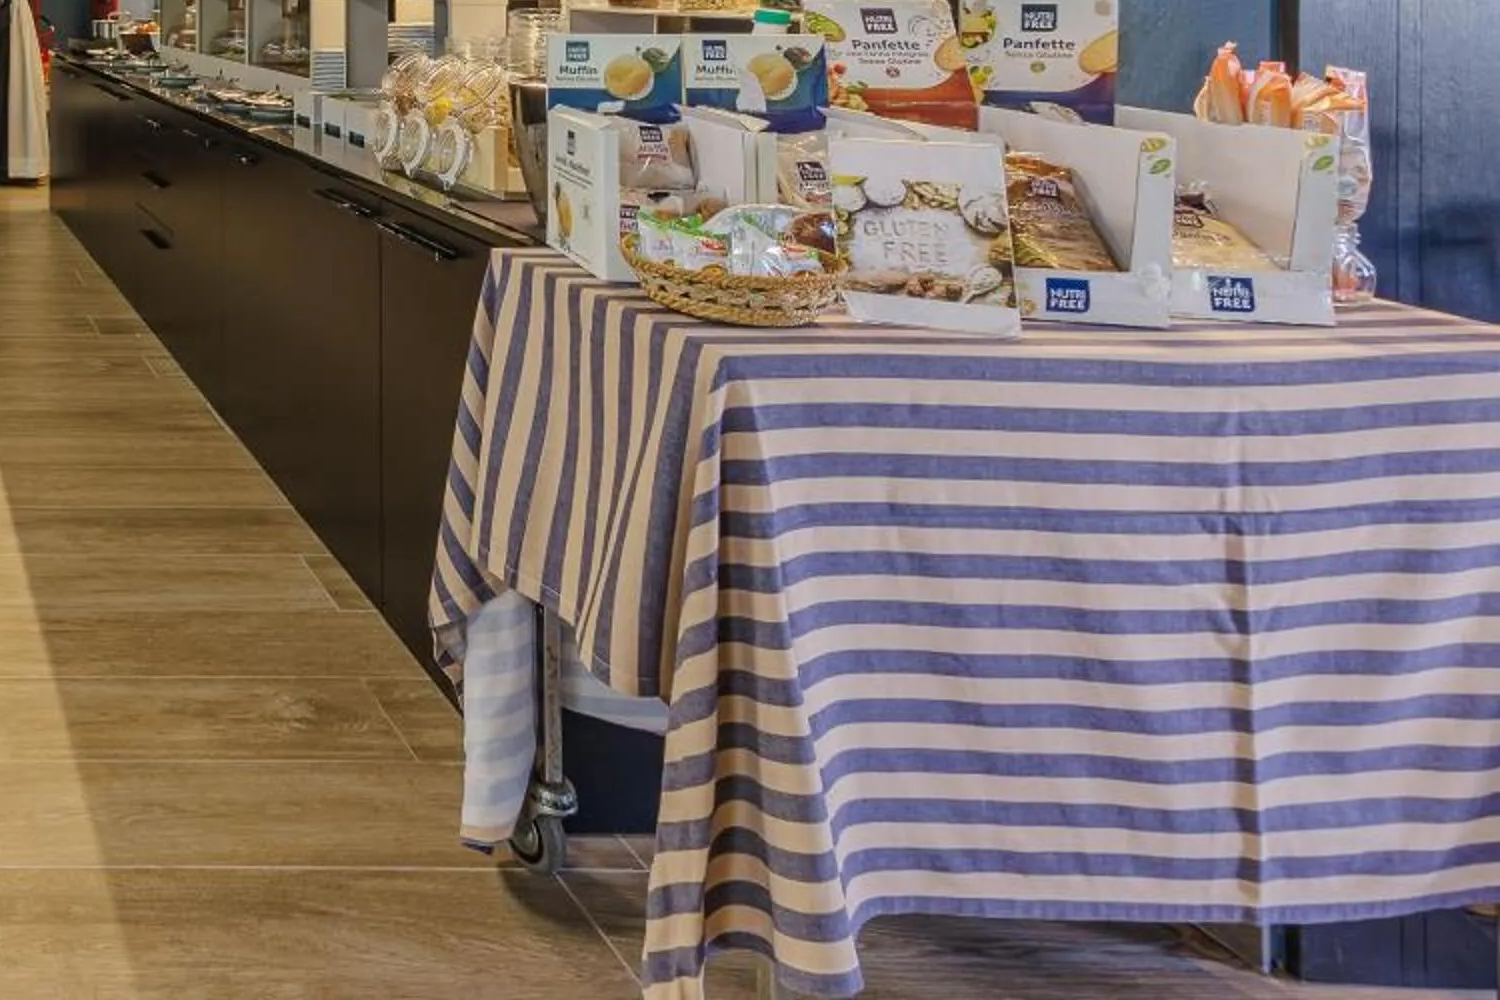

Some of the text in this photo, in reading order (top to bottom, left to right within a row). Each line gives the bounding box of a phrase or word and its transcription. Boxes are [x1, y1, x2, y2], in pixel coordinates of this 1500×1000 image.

[1023, 20, 1053, 30] FREE
[851, 38, 921, 51] Panfette
[1003, 37, 1076, 50] Panfette
[560, 64, 599, 75] Muffin
[863, 218, 949, 238] GLUTEN
[882, 240, 949, 263] FREE
[1051, 288, 1086, 300] NUTRI
[1051, 299, 1086, 310] FREE
[1214, 297, 1252, 309] FREE
